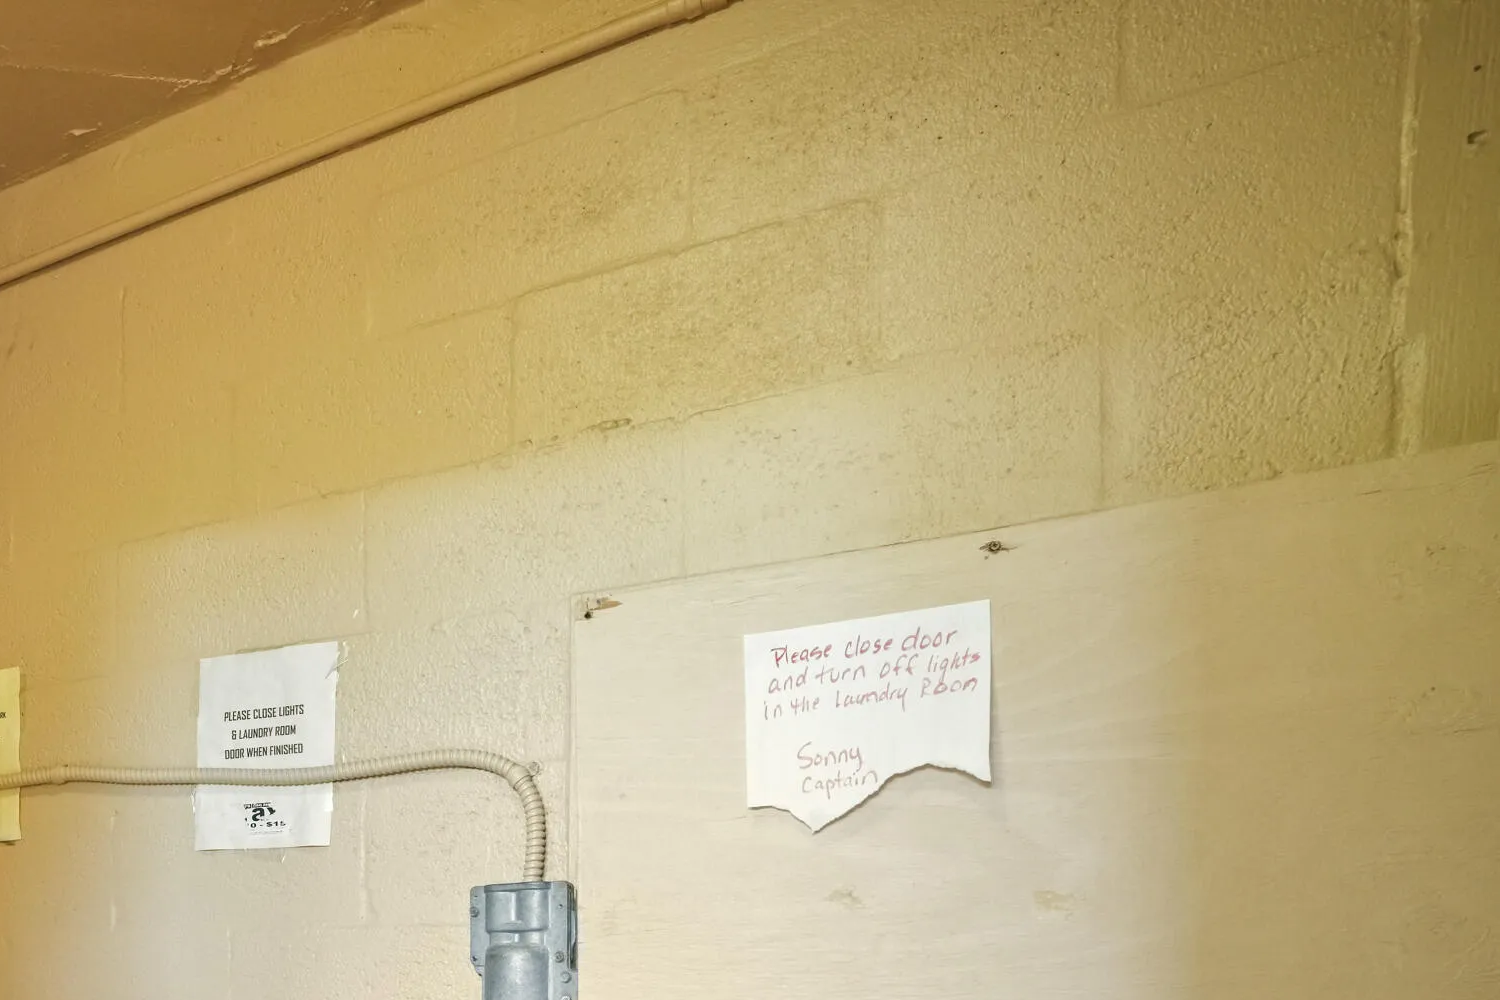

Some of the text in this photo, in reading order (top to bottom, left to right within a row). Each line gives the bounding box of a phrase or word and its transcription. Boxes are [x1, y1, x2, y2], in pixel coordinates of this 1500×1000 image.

[770, 644, 832, 669] Please
[901, 626, 958, 652] door
[768, 647, 981, 694] and turn off lights
[224, 704, 304, 722] PLEASE CLOSE LIGHTS
[763, 700, 783, 721] in
[238, 727, 274, 740] LAUNDRY
[275, 724, 297, 737] ROOM
[224, 743, 304, 760] DOOR WHEN FINISHED
[796, 740, 864, 773] Sonny
[802, 770, 879, 800] Captain
